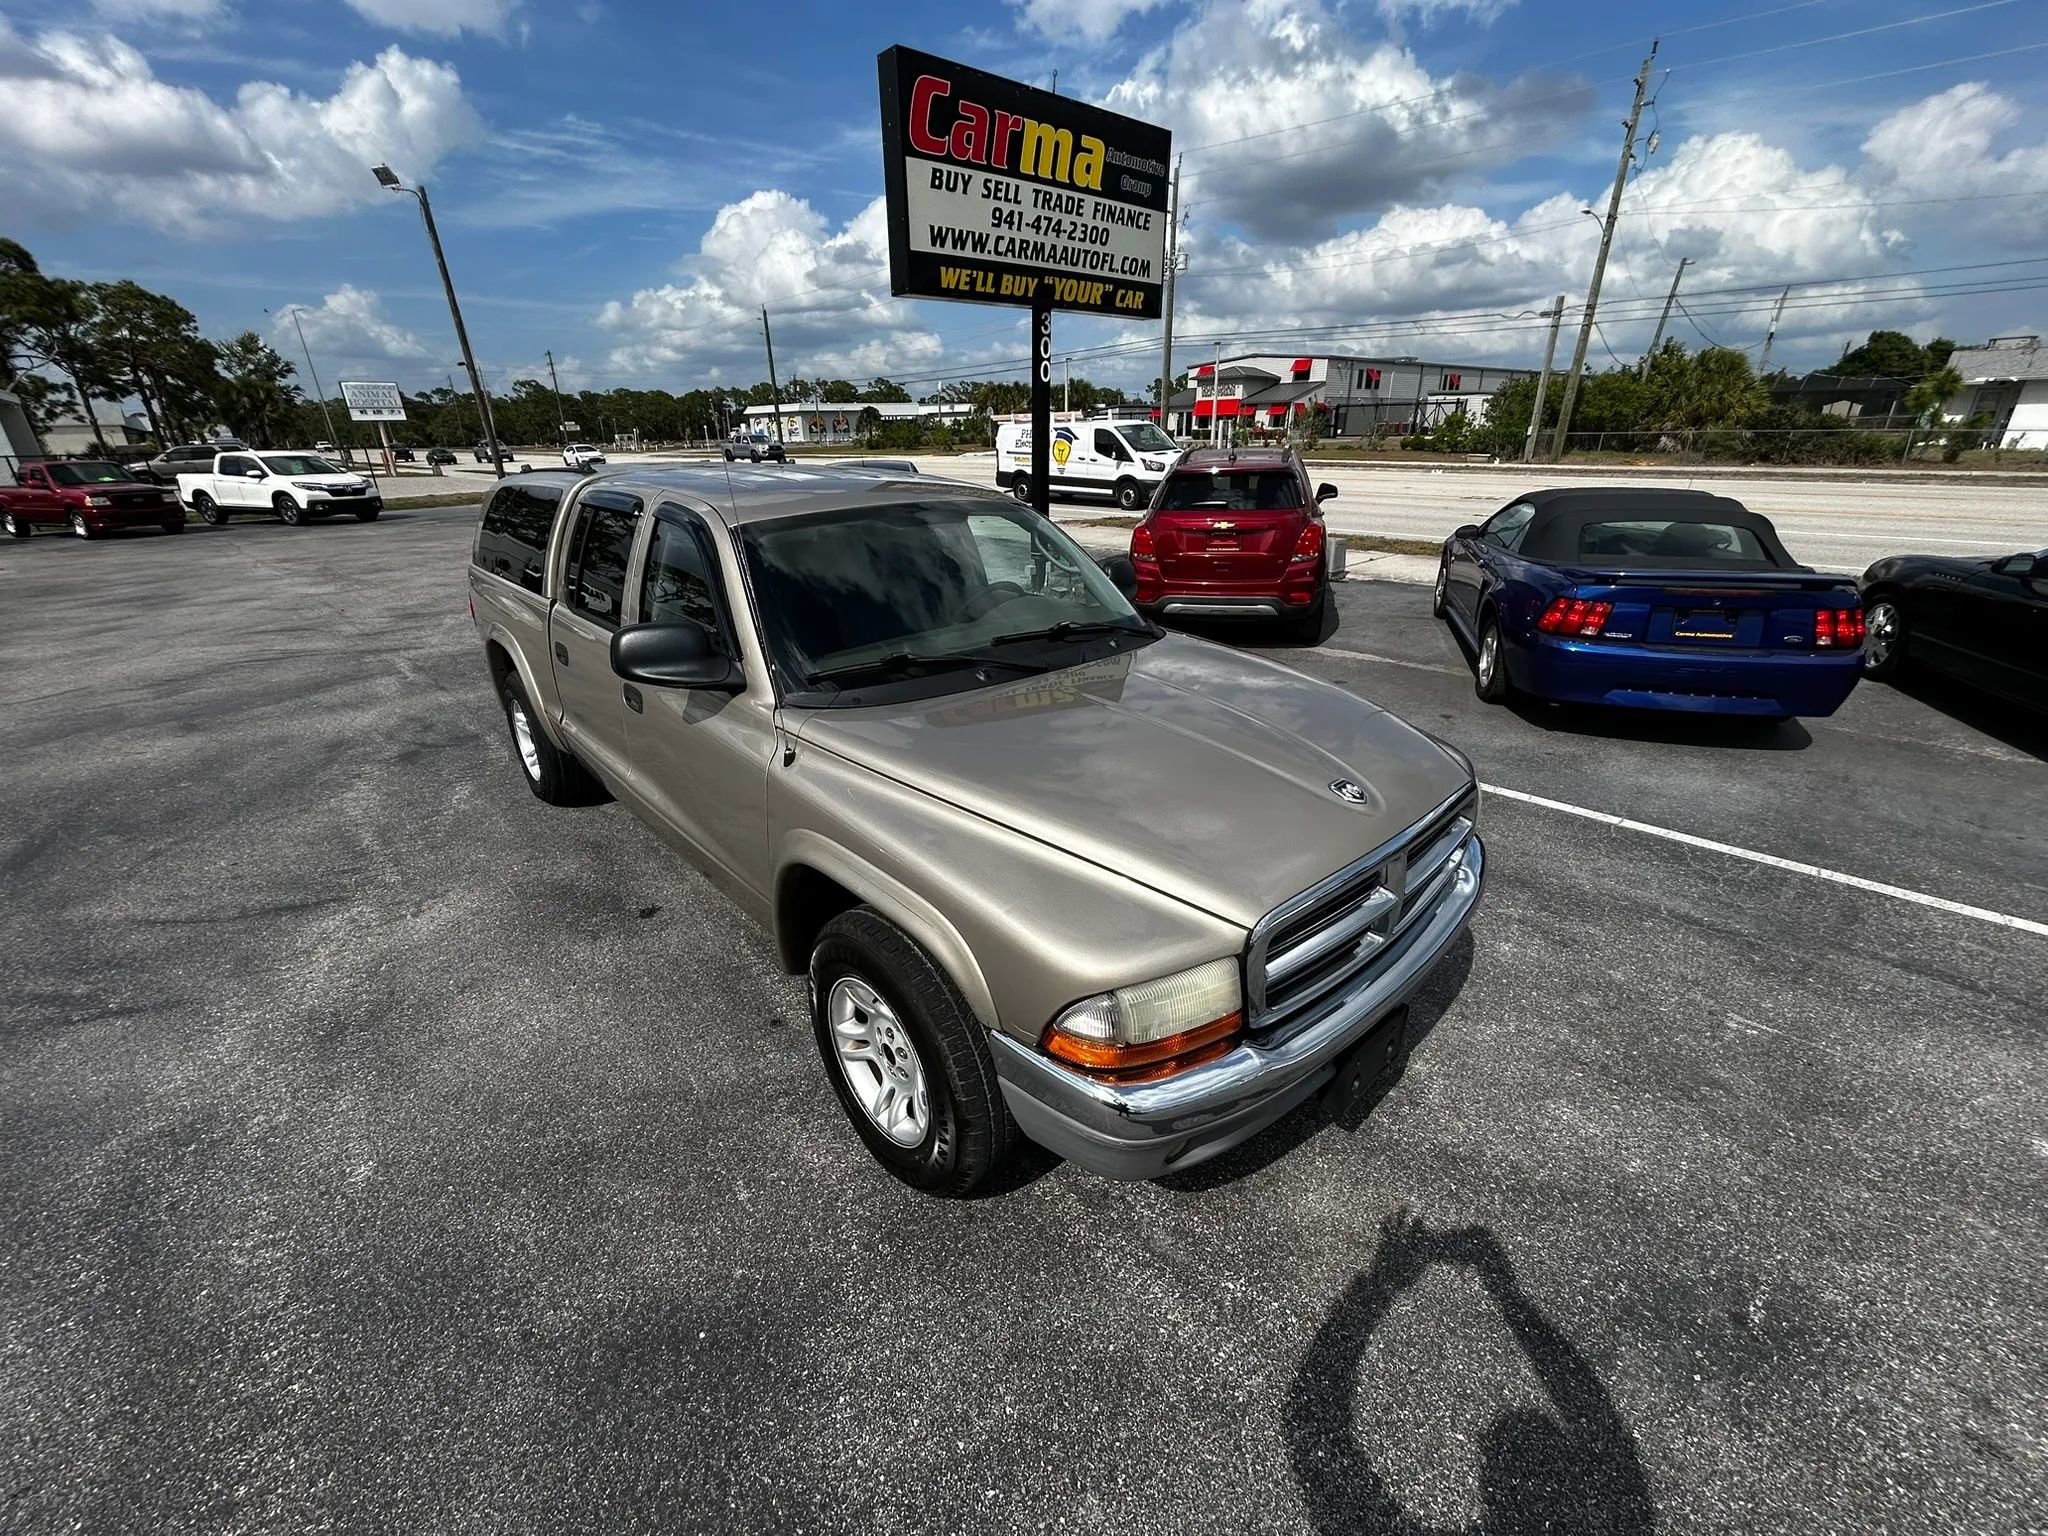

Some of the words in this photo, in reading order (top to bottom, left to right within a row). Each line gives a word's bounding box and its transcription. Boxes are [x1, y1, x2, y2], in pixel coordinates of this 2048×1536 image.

[909, 75, 1105, 190] Carma
[1106, 147, 1165, 177] Automotive
[930, 167, 972, 195] BUY
[981, 177, 1022, 205] SELL
[1032, 188, 1084, 217] TRADE
[1093, 200, 1152, 232] FINANCE
[1121, 175, 1152, 198] Group
[991, 207, 1110, 247] 941-474-2300
[929, 224, 1151, 278] WWW.CARMAAUTOFL.COM
[940, 266, 995, 293] WE'LL
[1001, 273, 1038, 298] BUY
[1044, 276, 1113, 305] "YOUR"
[1116, 289, 1144, 310] CAR
